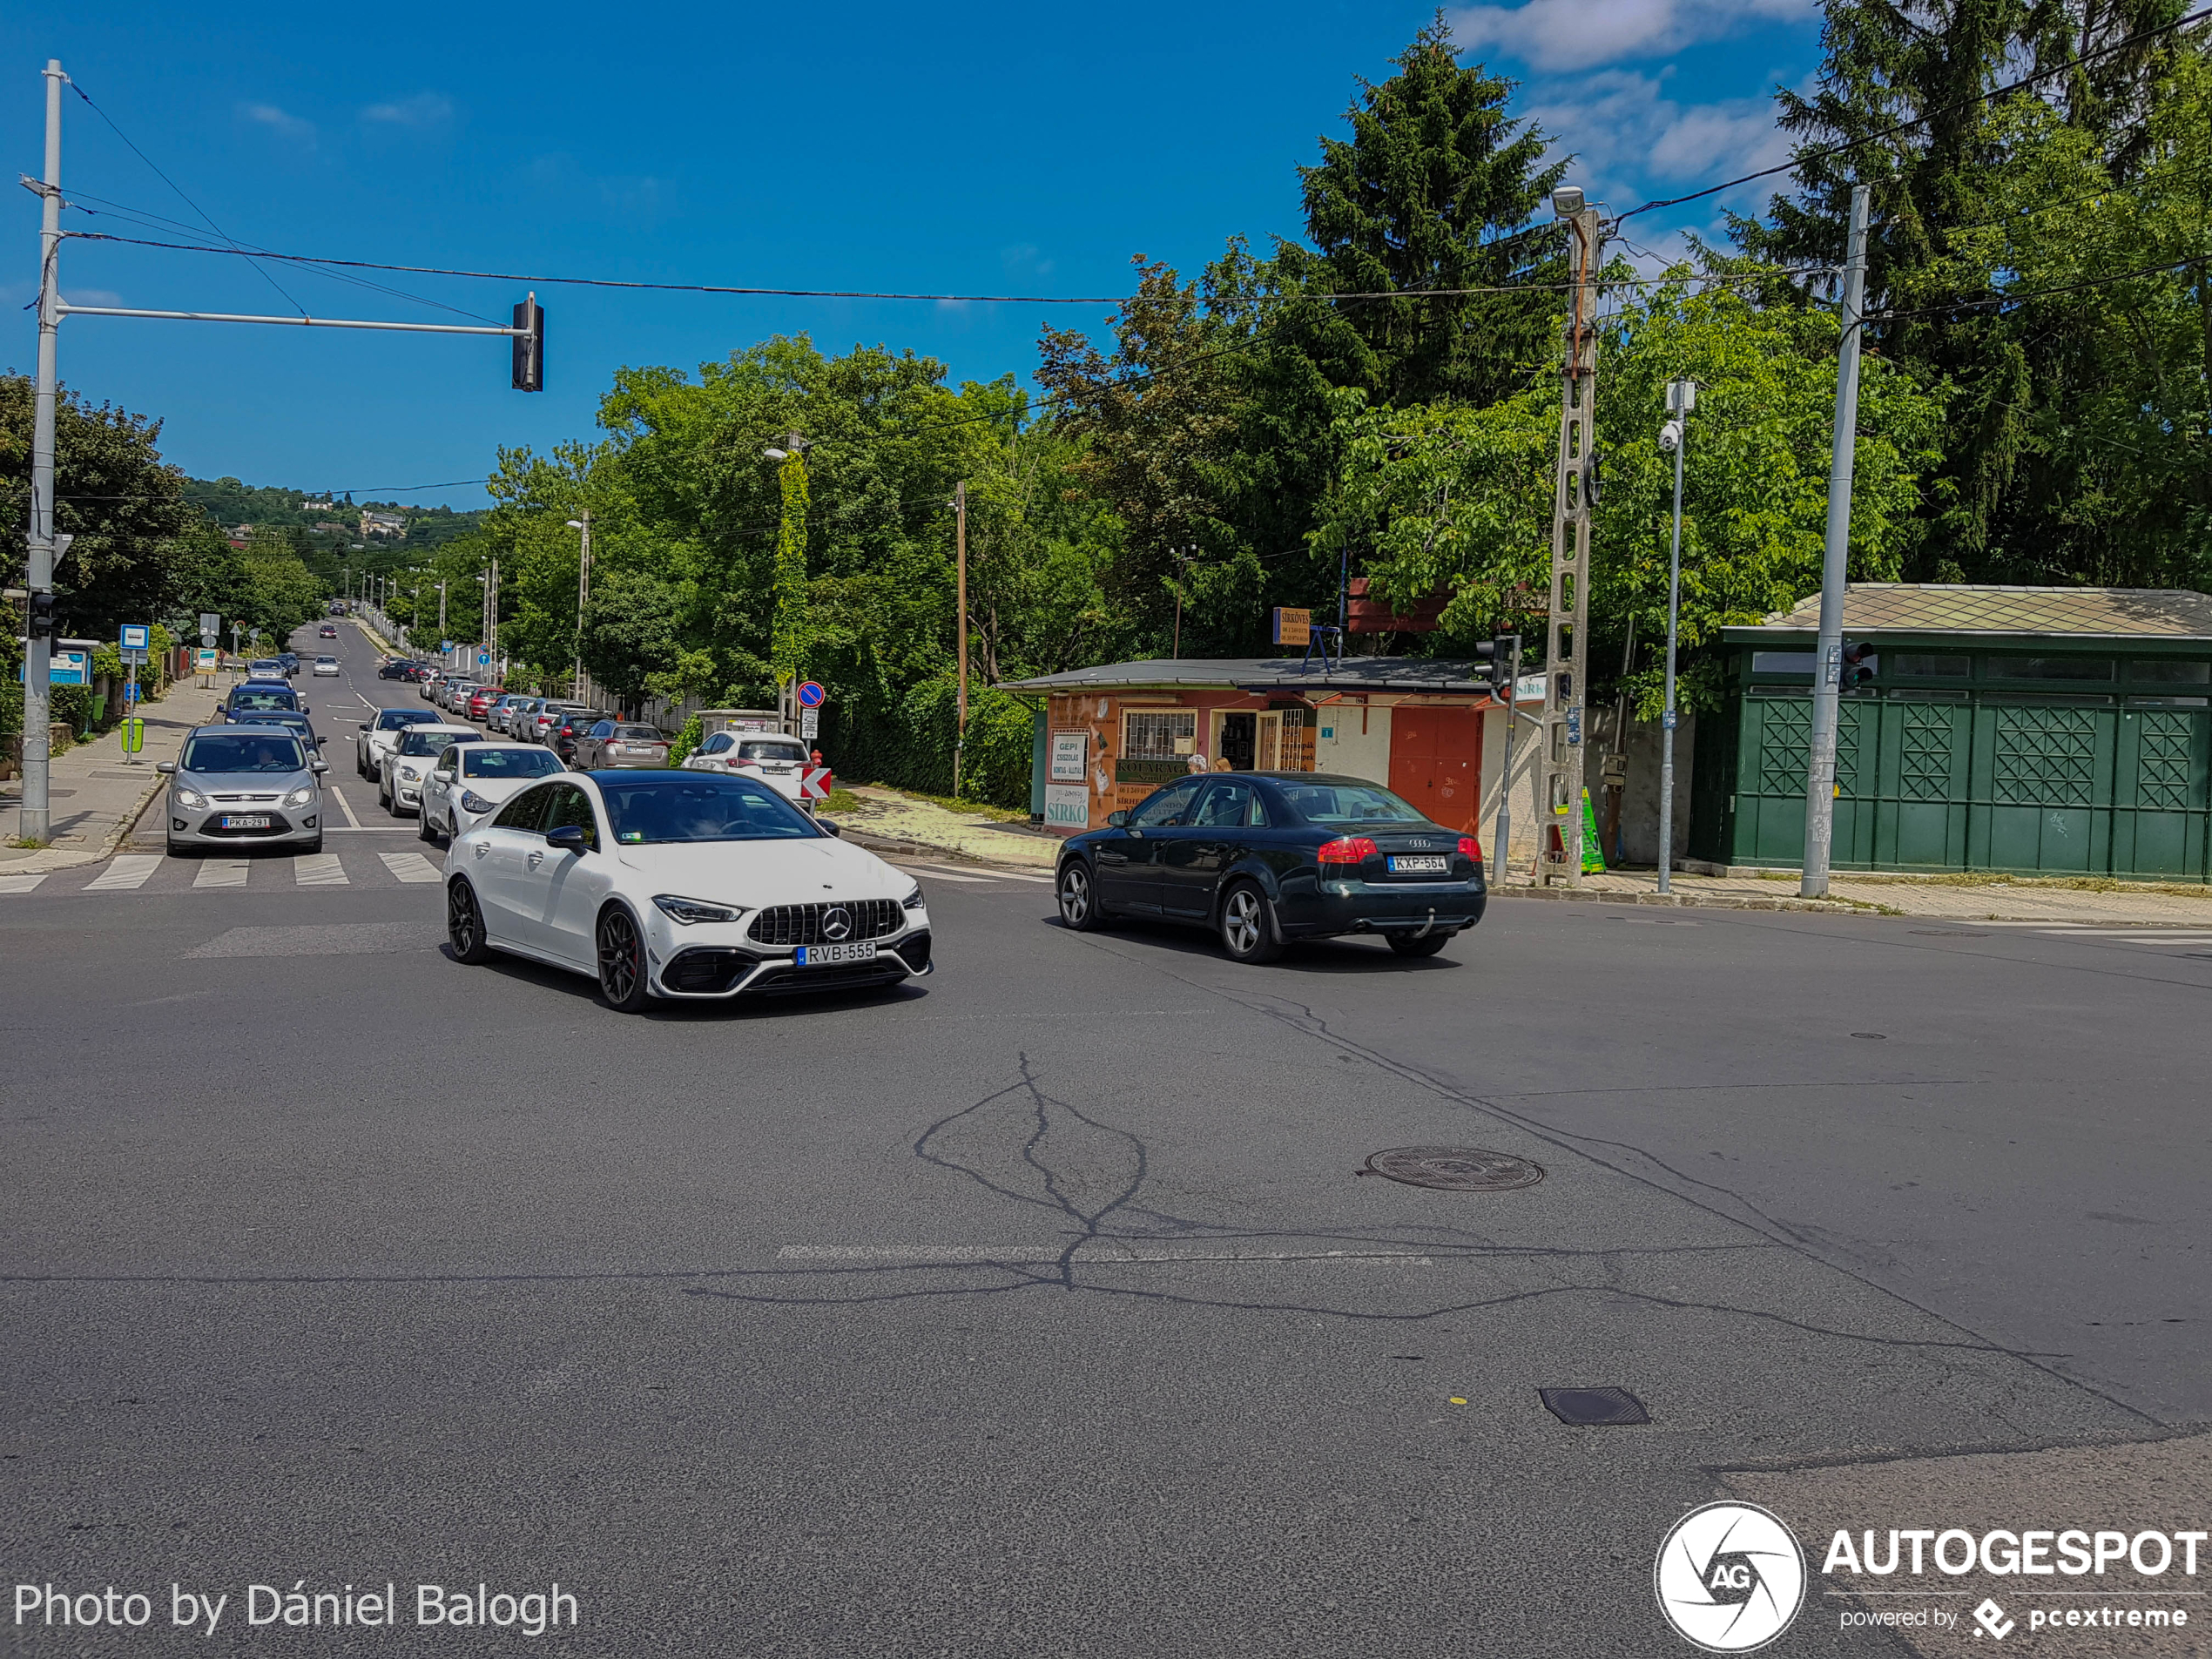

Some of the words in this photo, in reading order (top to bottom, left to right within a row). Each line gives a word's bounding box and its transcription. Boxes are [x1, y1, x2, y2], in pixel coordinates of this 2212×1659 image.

[1282, 610, 1308, 624] SÍRKÖVES
[1056, 752, 1079, 761] CSISZOLÁS
[1047, 798, 1088, 823] SÍRKŐ
[1396, 857, 1444, 869] KXP-564
[809, 943, 873, 962] RVB-555
